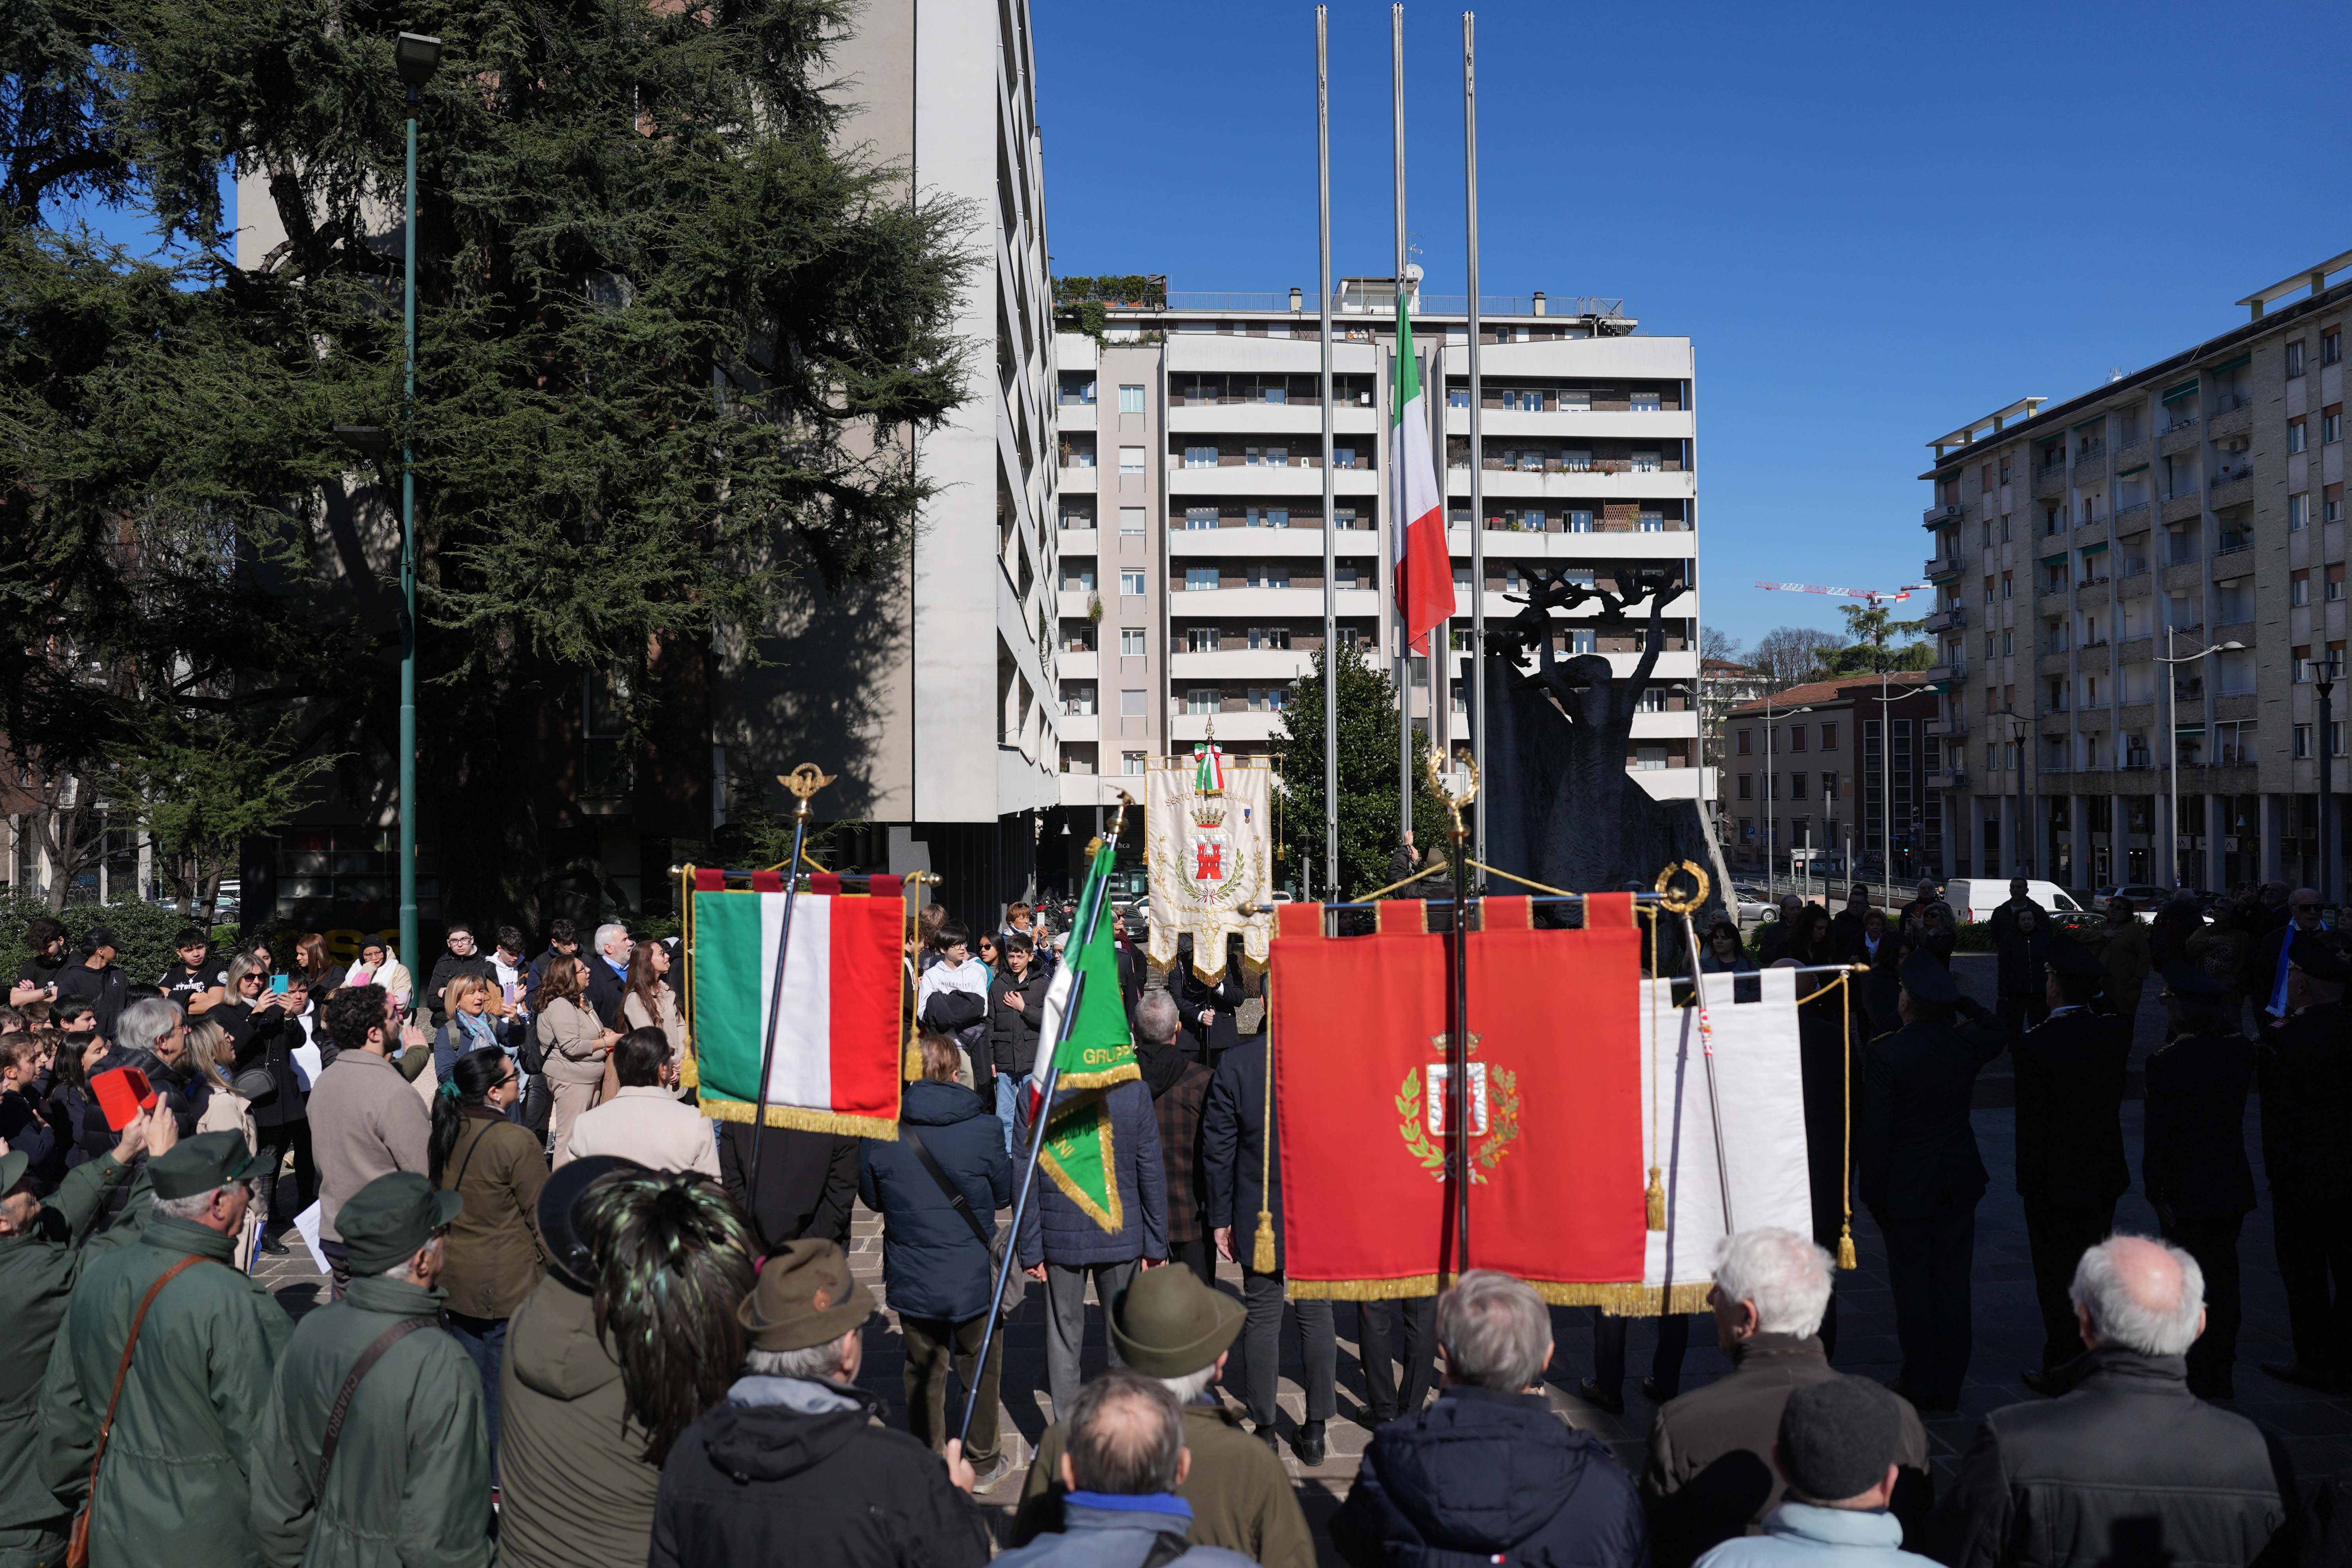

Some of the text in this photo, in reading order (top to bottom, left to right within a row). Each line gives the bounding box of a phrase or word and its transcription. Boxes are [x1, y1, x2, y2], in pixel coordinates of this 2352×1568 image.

[1165, 792, 1191, 806] SESTO
[1083, 1045, 1137, 1065] GRUPP
[328, 1374, 358, 1437] CHARRO
